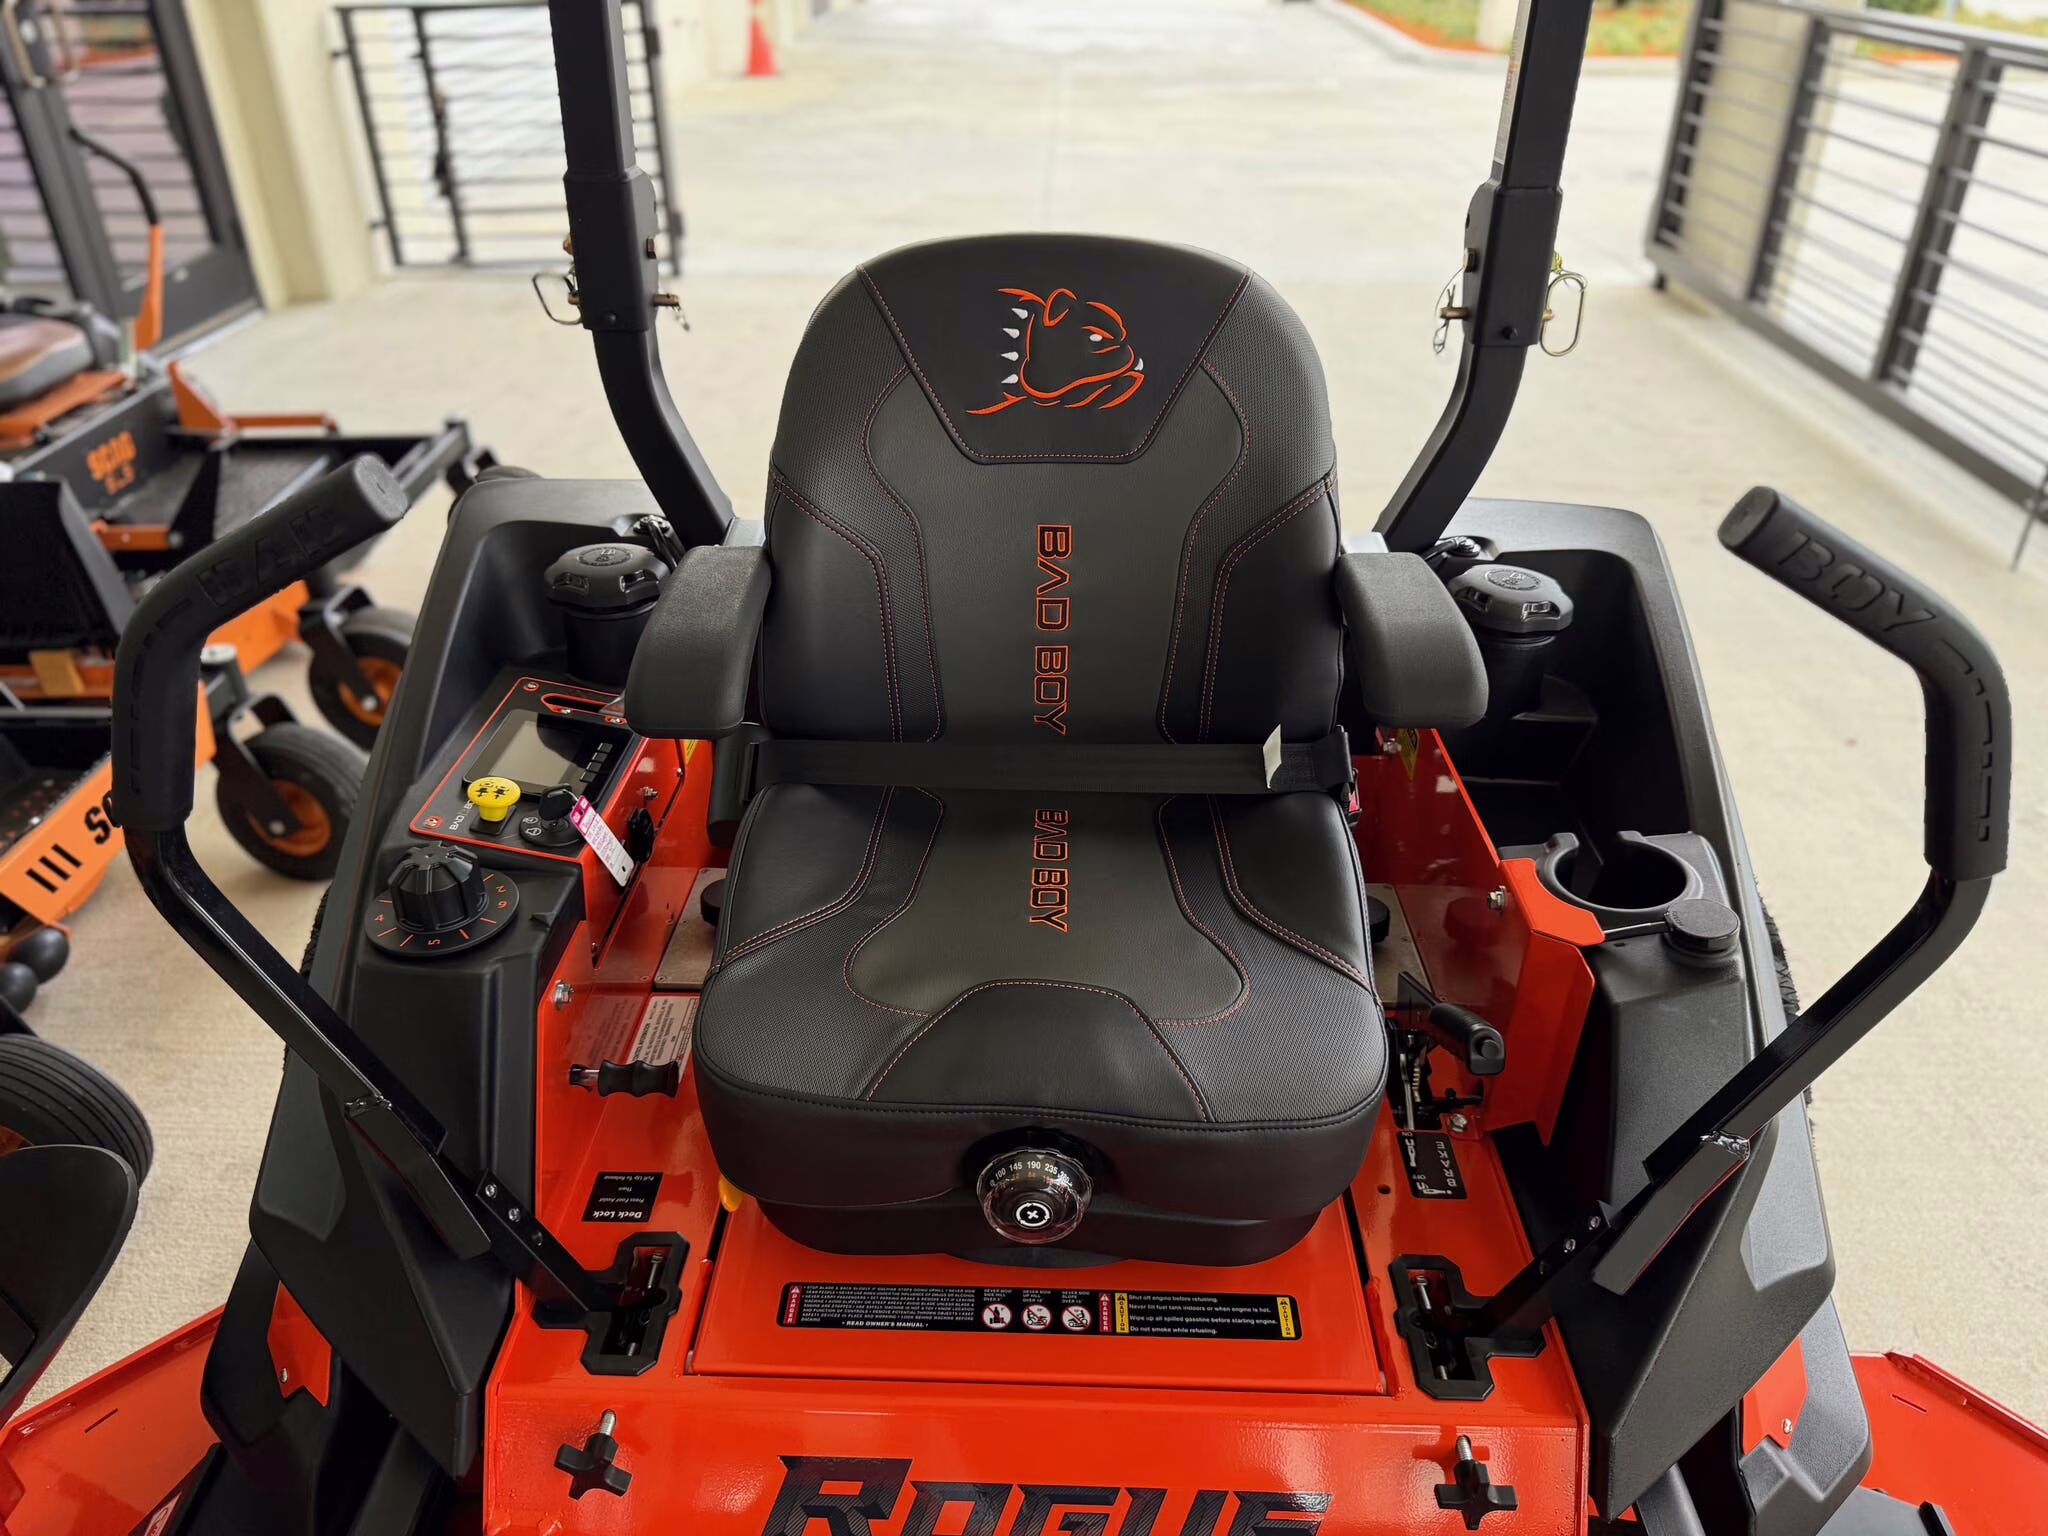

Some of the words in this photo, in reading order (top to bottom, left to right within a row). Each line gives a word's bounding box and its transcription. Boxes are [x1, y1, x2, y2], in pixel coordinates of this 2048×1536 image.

[1036, 524, 1073, 632] BAD
[1777, 530, 1937, 633] BOY
[1034, 645, 1069, 736] BOY
[1034, 808, 1068, 861] BAD
[1029, 867, 1068, 933] BOY
[995, 1168, 1007, 1180] 100
[1009, 1161, 1023, 1172] 145
[1027, 1160, 1041, 1169] 190
[1044, 1162, 1058, 1175] 235
[1435, 1140, 1457, 1188] BRAKE
[592, 1210, 616, 1218] Lock
[618, 1210, 642, 1219] Deck
[787, 1294, 798, 1324] DANGER
[1281, 1306, 1292, 1336] CAUTION
